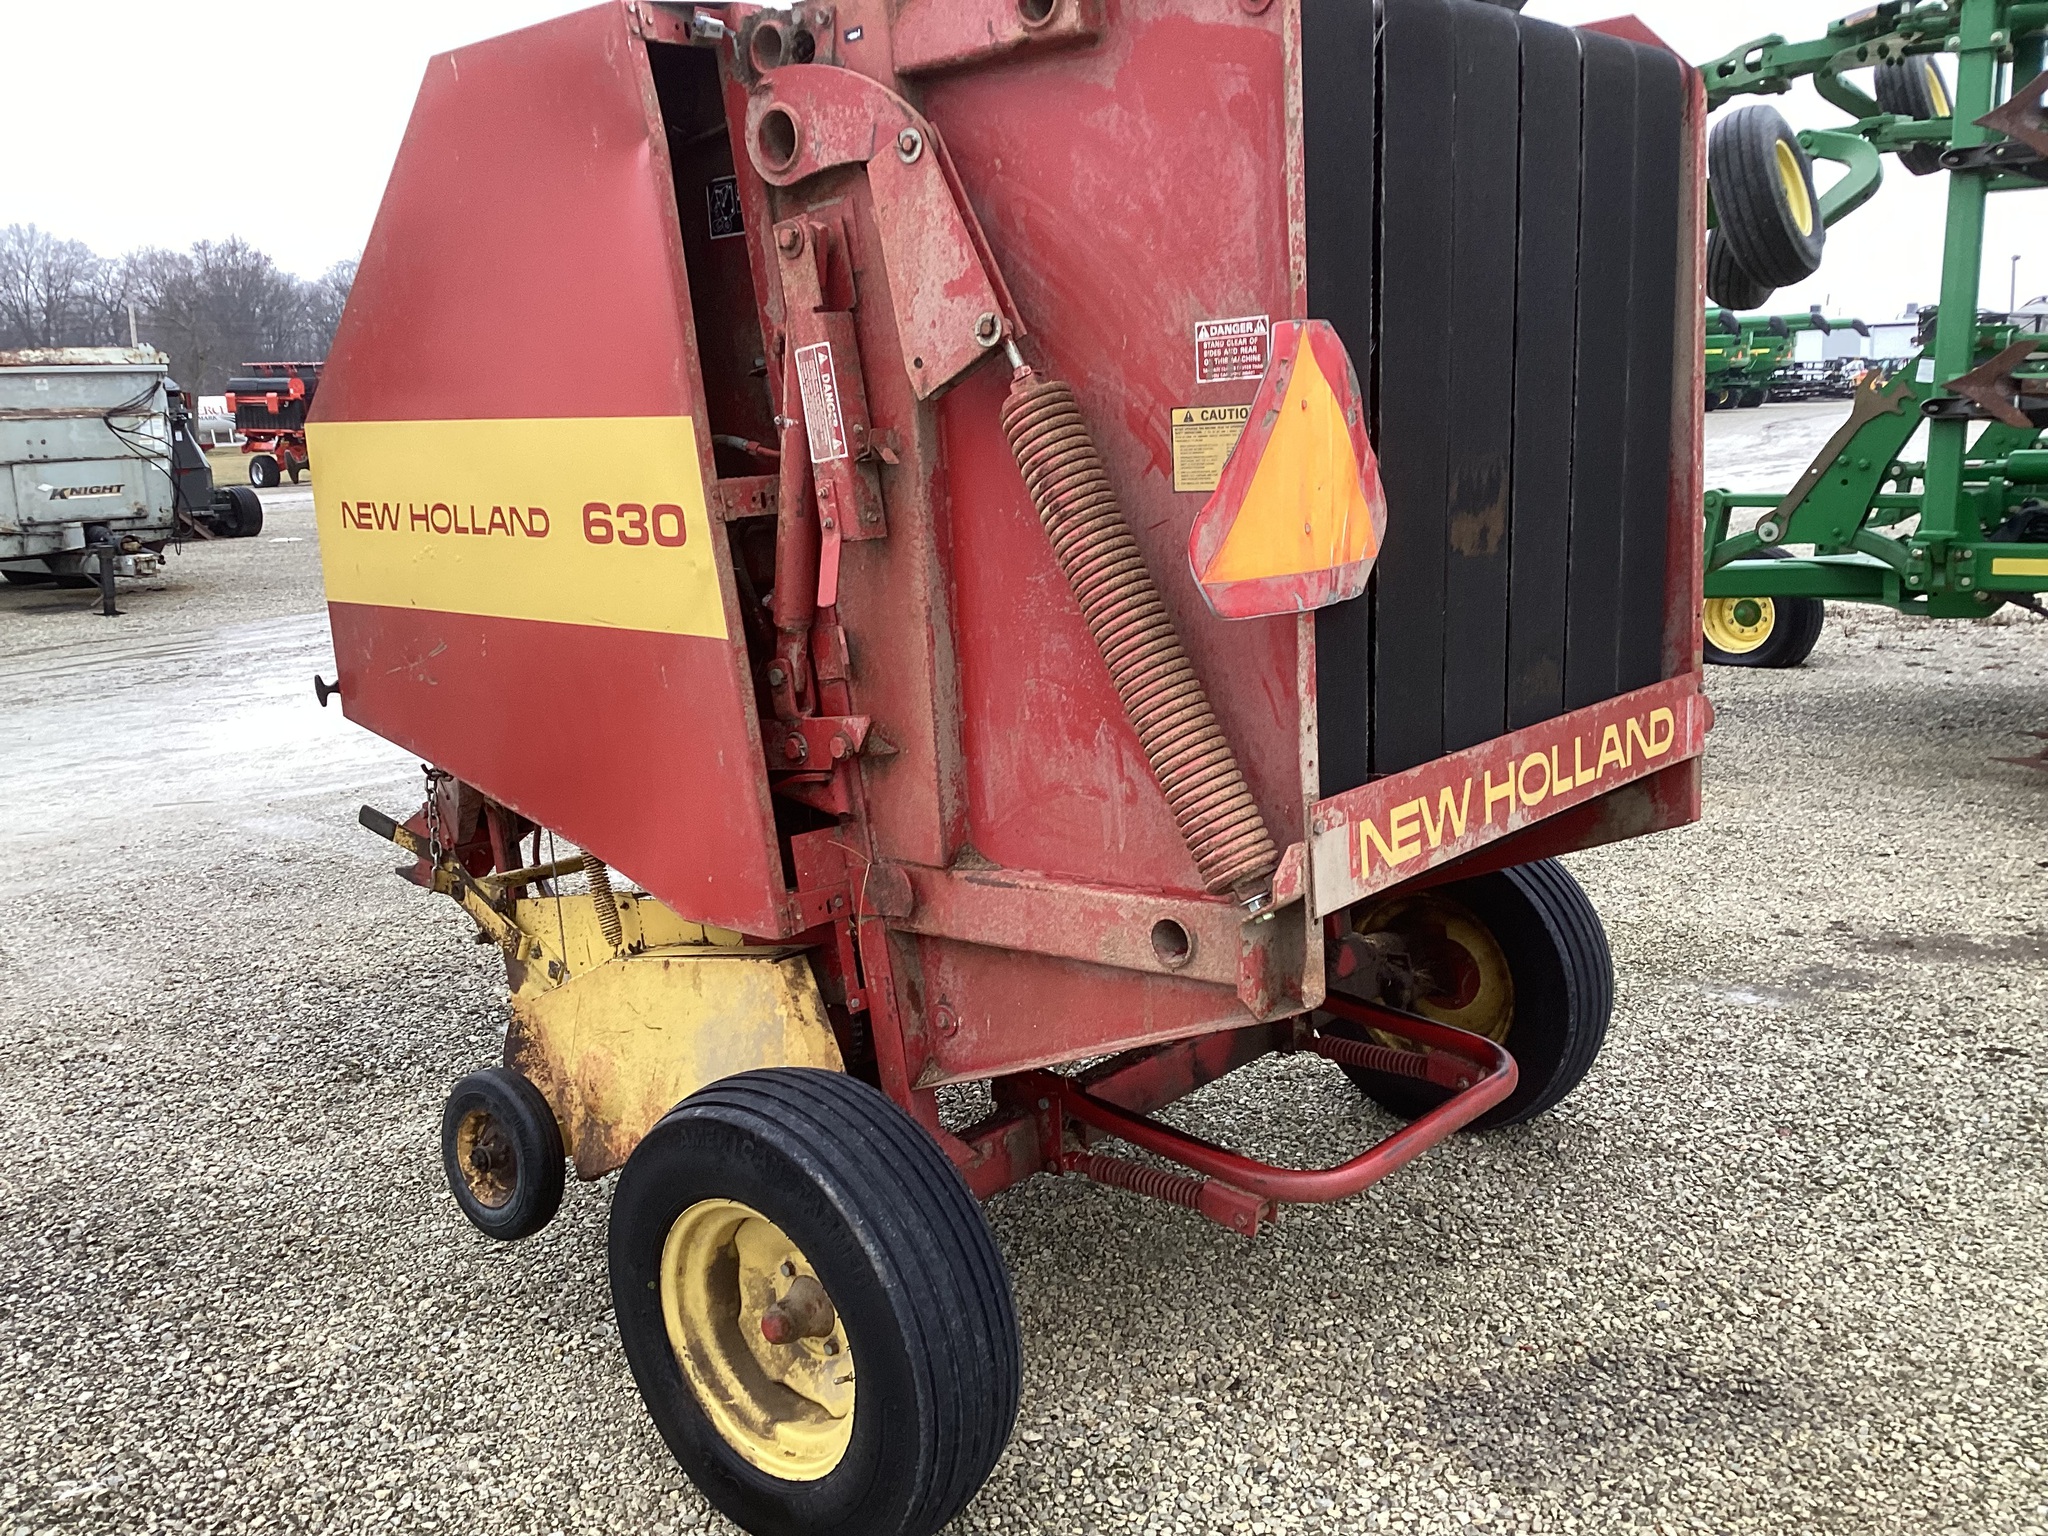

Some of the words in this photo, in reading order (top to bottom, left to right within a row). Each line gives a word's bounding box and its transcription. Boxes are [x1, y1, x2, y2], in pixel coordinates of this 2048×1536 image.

[1209, 322, 1253, 337] DANGER
[1203, 340, 1225, 350] STAND
[1226, 337, 1248, 347] CLEAR
[1249, 336, 1258, 345] OF
[1240, 345, 1258, 354] REAR
[1203, 358, 1212, 367] O
[1214, 356, 1229, 365] THIS
[1200, 407, 1251, 421] CAUTIO
[49, 484, 126, 501] KNIGHT
[341, 501, 401, 531] NEW
[409, 502, 550, 538] HOLLAND
[582, 502, 688, 547] 630
[1359, 777, 1472, 880] NEW
[1484, 706, 1675, 824] HOLLAND
